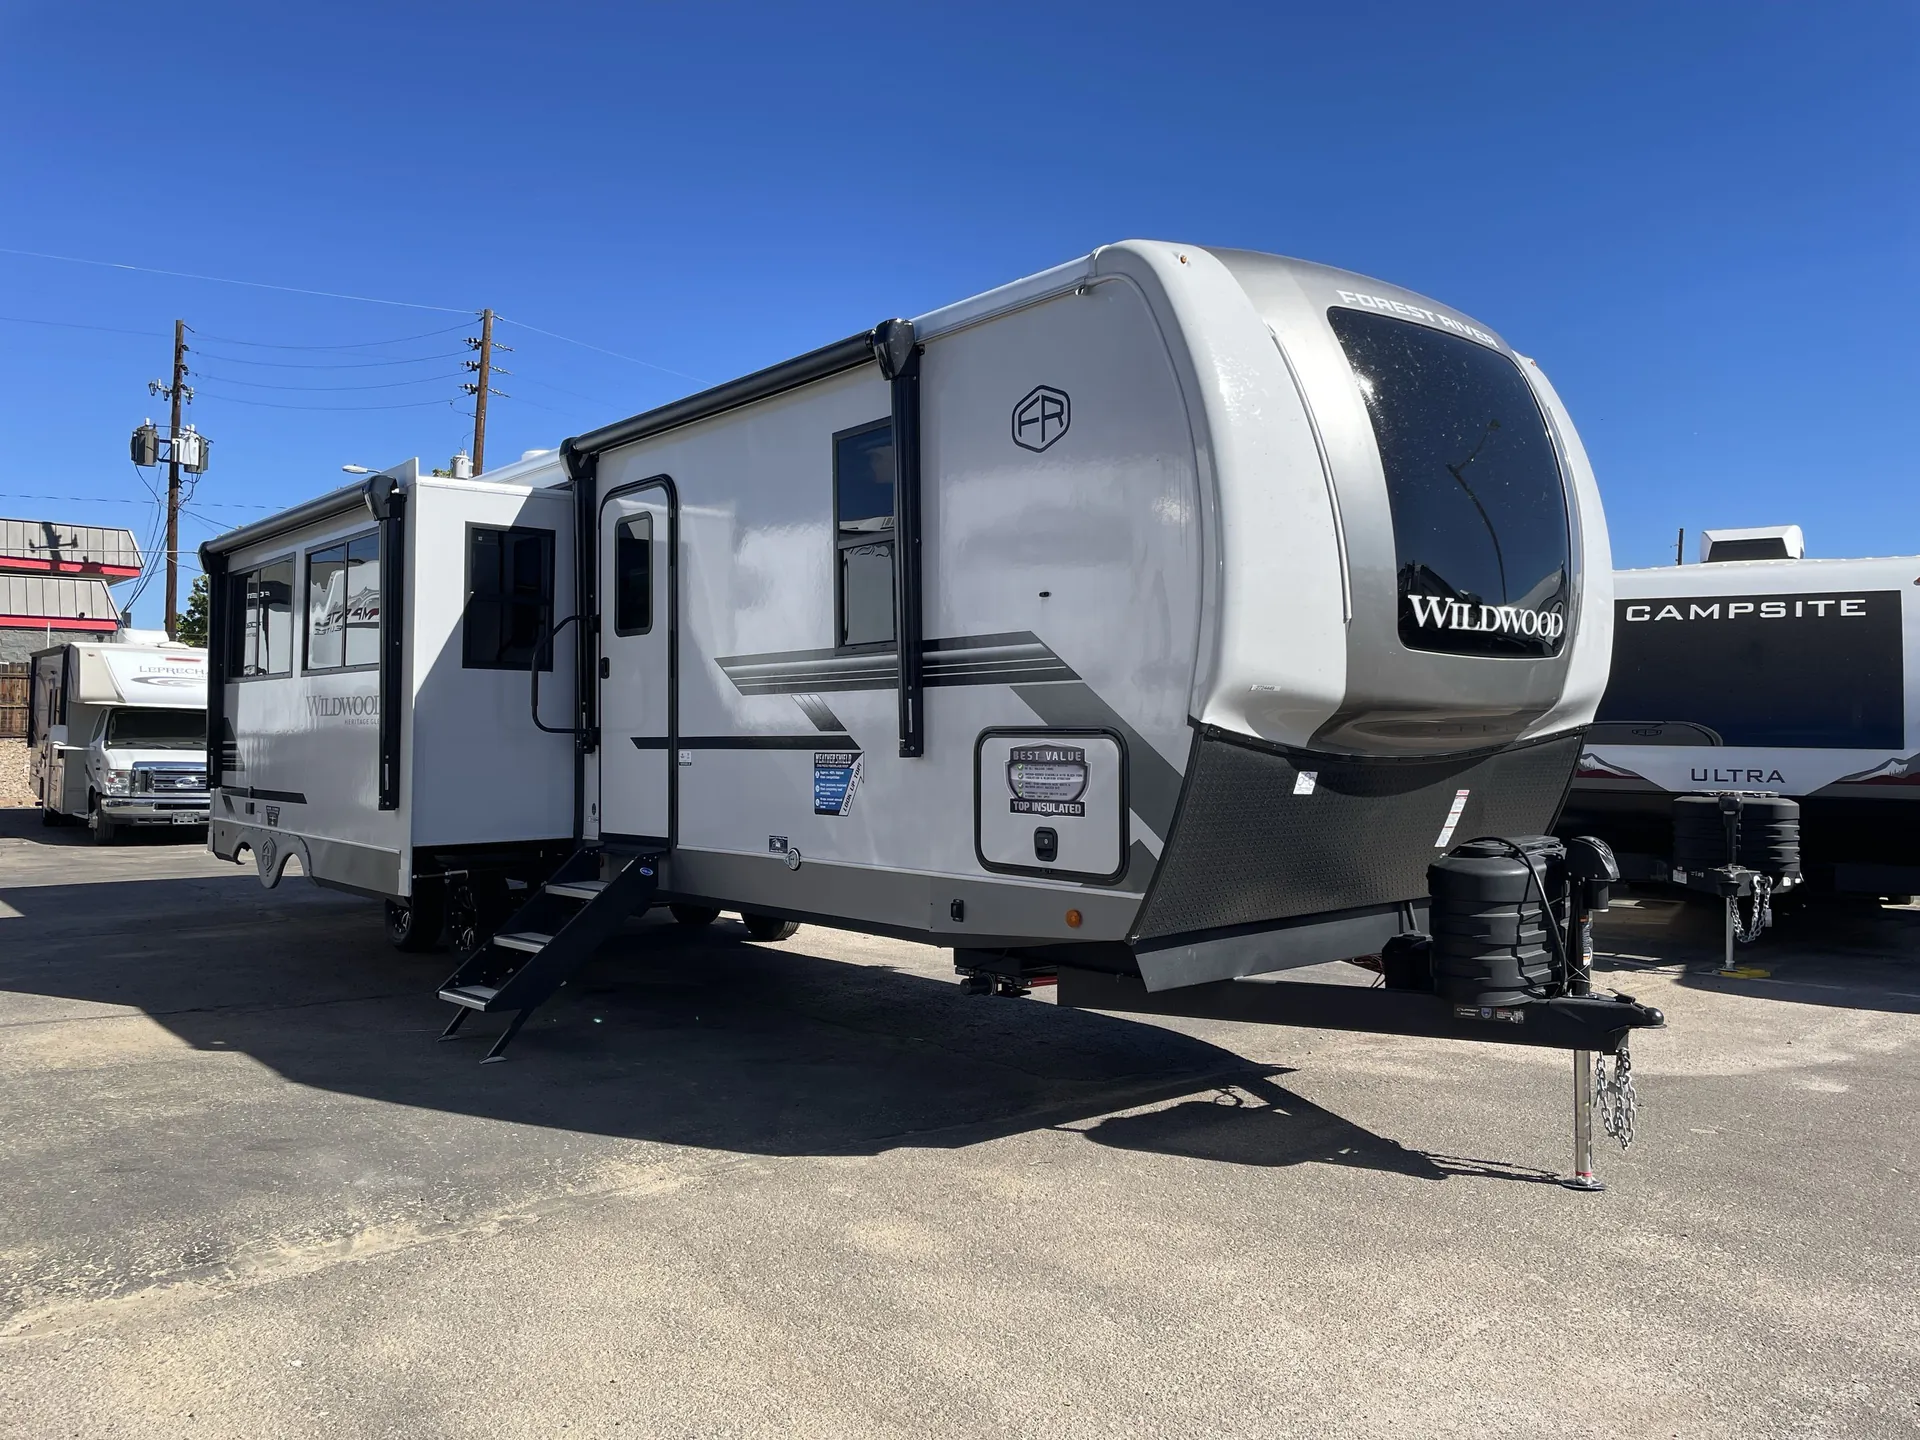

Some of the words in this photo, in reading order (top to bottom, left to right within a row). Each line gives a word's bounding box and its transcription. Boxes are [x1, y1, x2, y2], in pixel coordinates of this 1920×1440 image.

[1336, 289, 1435, 323] FOREST
[1436, 313, 1499, 349] RIVER
[1407, 594, 1563, 638] WILDWOOD
[1625, 599, 1866, 622] CAMPSITE
[139, 665, 208, 675] LEPRECH
[1013, 751, 1040, 761] BEST
[1045, 751, 1081, 761] VALUE
[1691, 768, 1786, 784] ULTRA
[1013, 801, 1030, 811] TOP
[1032, 802, 1081, 814] INSULATED
